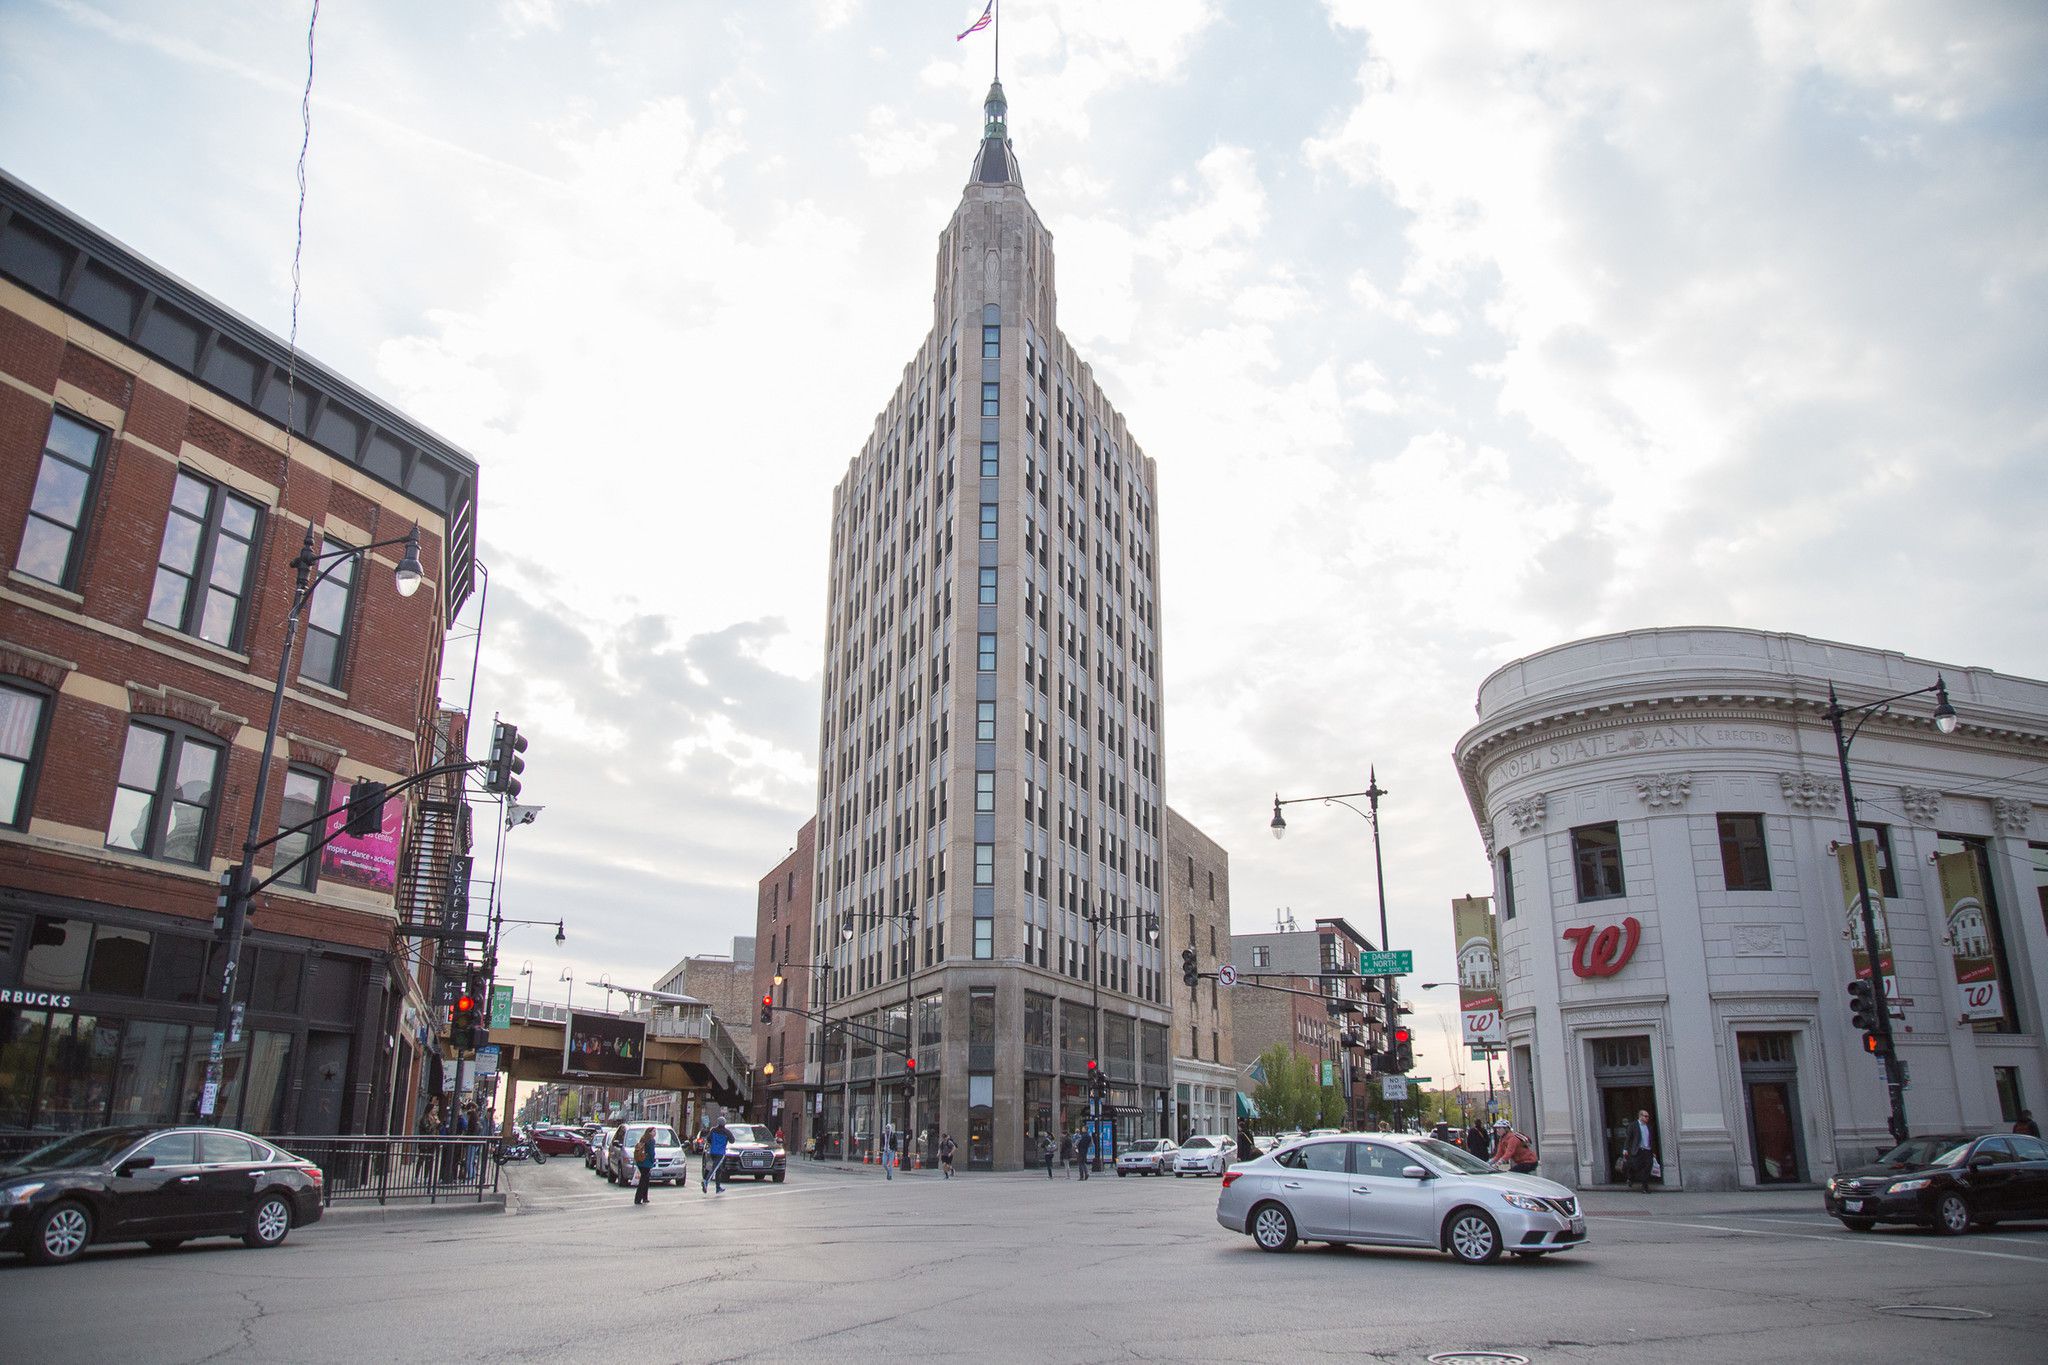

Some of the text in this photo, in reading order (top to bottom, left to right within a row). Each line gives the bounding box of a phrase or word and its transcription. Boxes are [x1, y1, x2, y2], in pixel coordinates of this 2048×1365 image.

[1500, 752, 1541, 780] NOEL
[1550, 733, 1616, 765] STATE
[1632, 725, 1712, 750] BANK
[1717, 729, 1767, 743] ERECTED
[374, 832, 394, 843] centre
[326, 843, 395, 866] inspire dance achieve
[1373, 960, 1397, 968] NORTH
[0, 990, 71, 1008] RBUCKS
